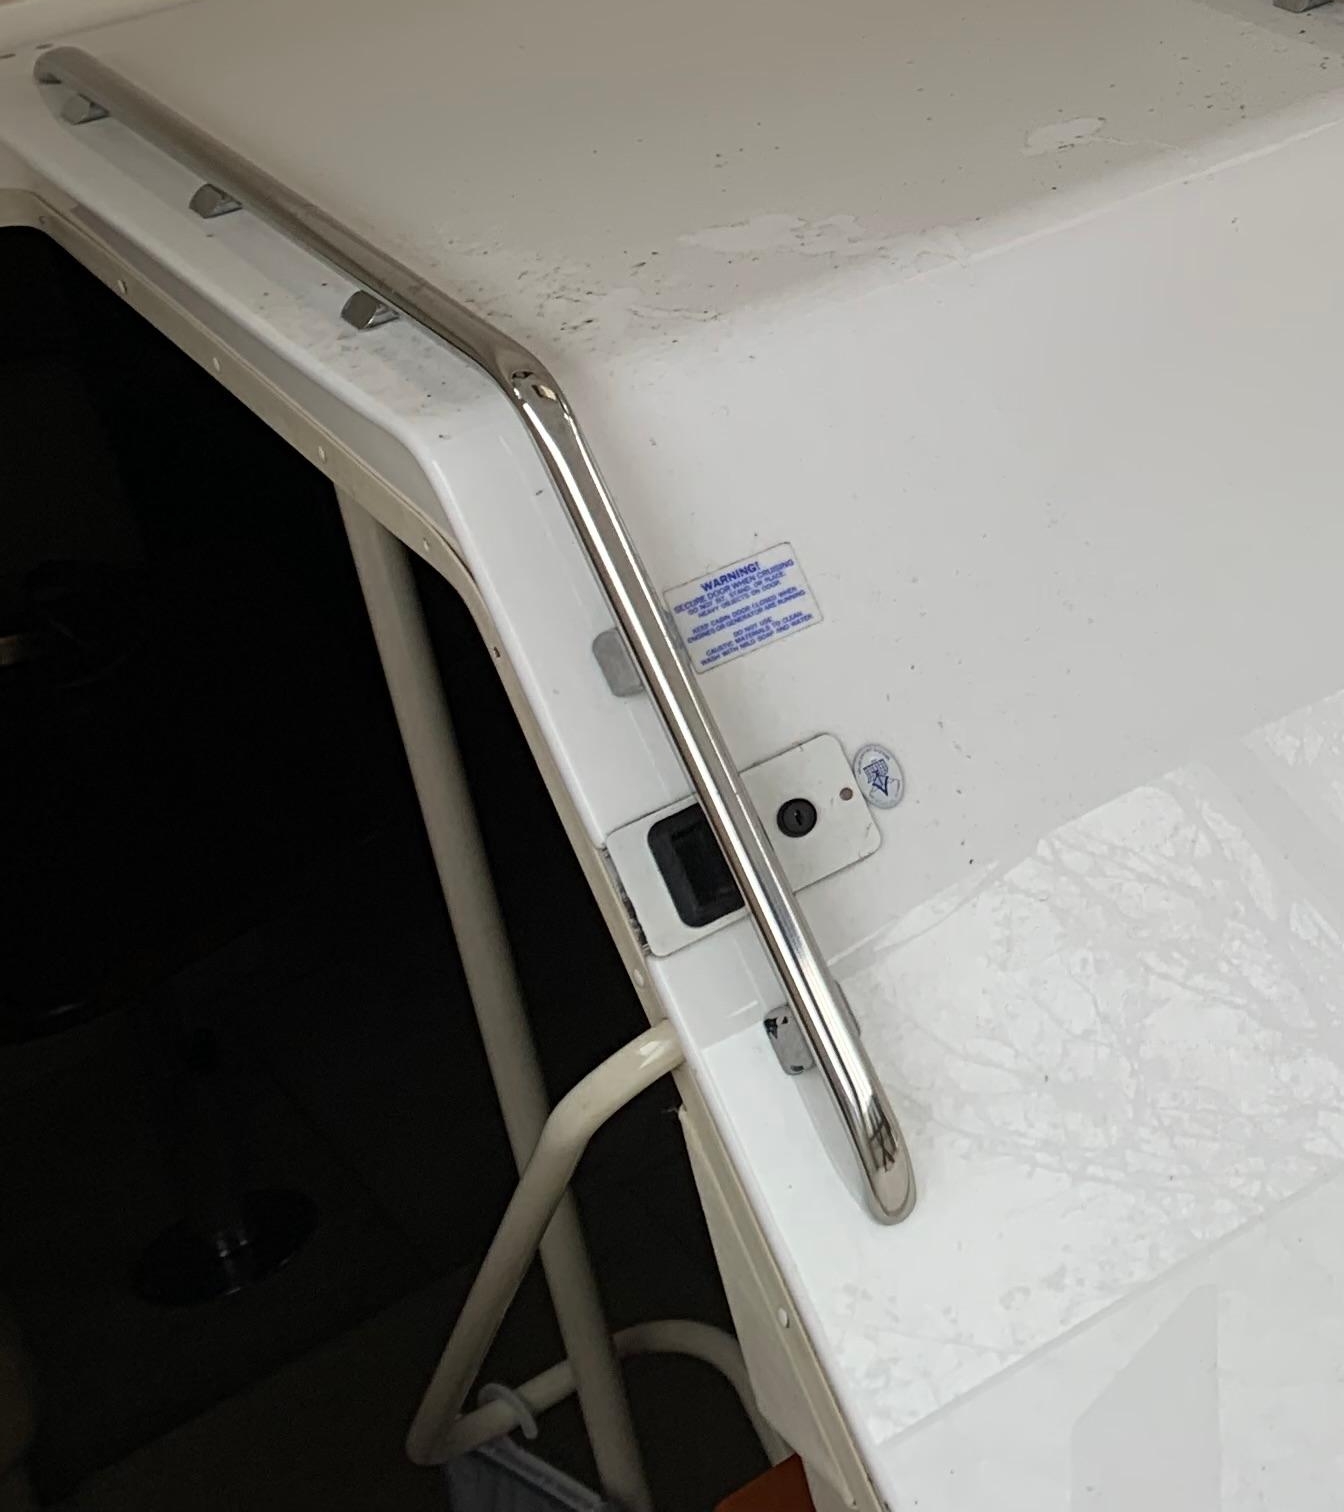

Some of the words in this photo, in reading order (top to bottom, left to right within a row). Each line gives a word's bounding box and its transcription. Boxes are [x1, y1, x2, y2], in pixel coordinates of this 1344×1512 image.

[701, 561, 760, 591] WARNING!
[673, 595, 706, 614] SECURE
[706, 585, 730, 600] DOOR
[731, 575, 756, 589] WHEN
